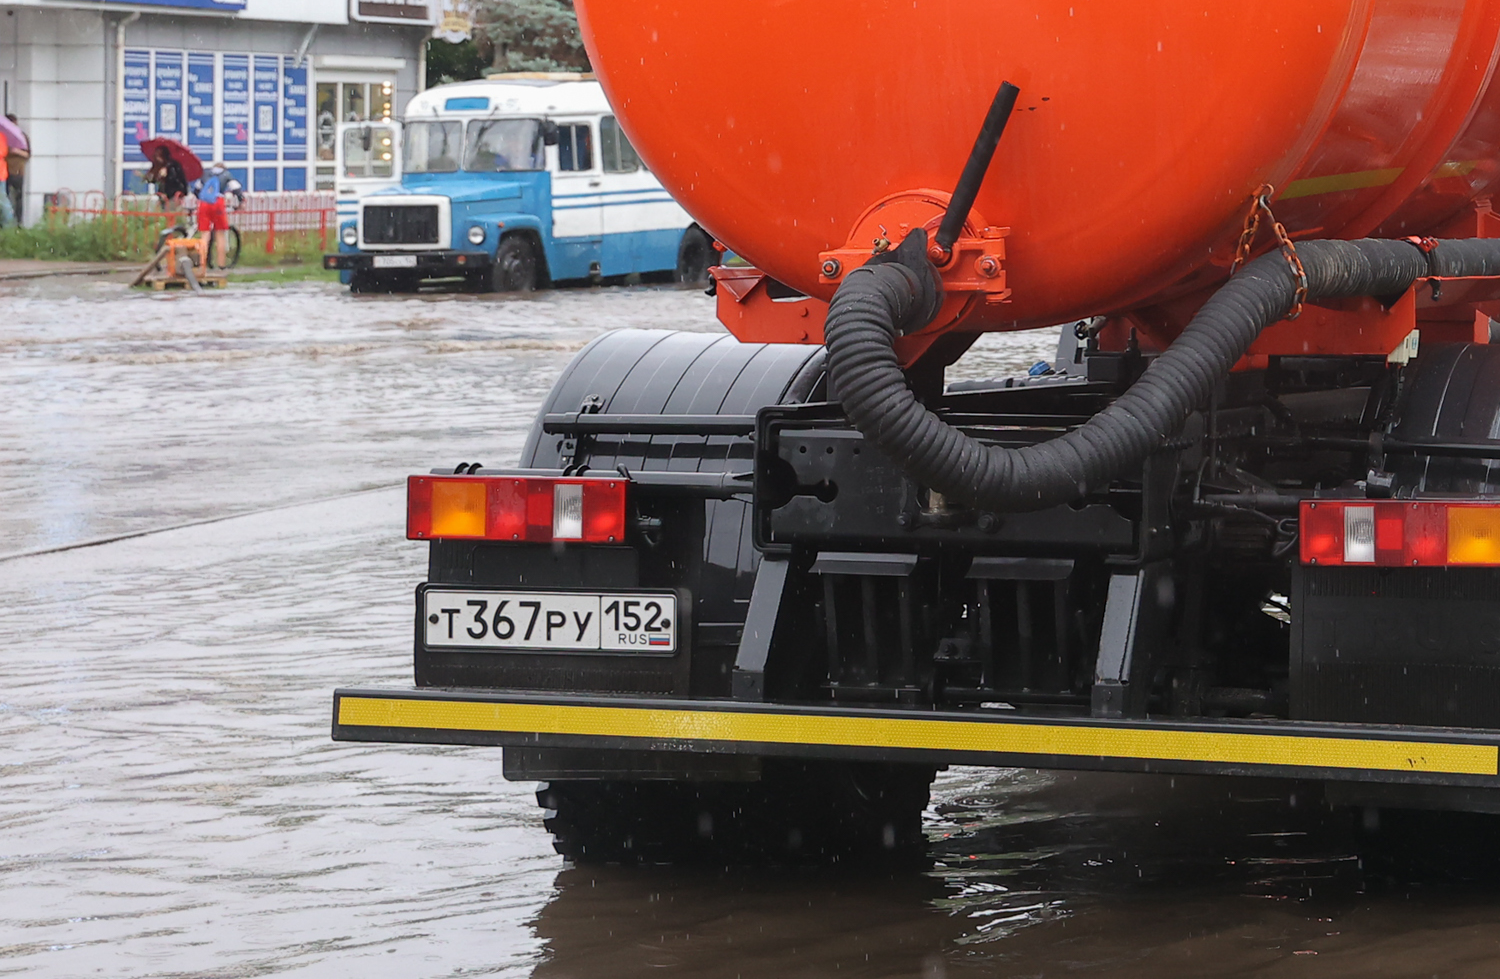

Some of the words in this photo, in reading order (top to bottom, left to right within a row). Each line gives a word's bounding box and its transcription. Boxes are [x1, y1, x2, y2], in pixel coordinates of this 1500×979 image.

[440, 600, 593, 642] Т367РУ
[604, 600, 663, 632] 152
[618, 633, 648, 645] RUS
